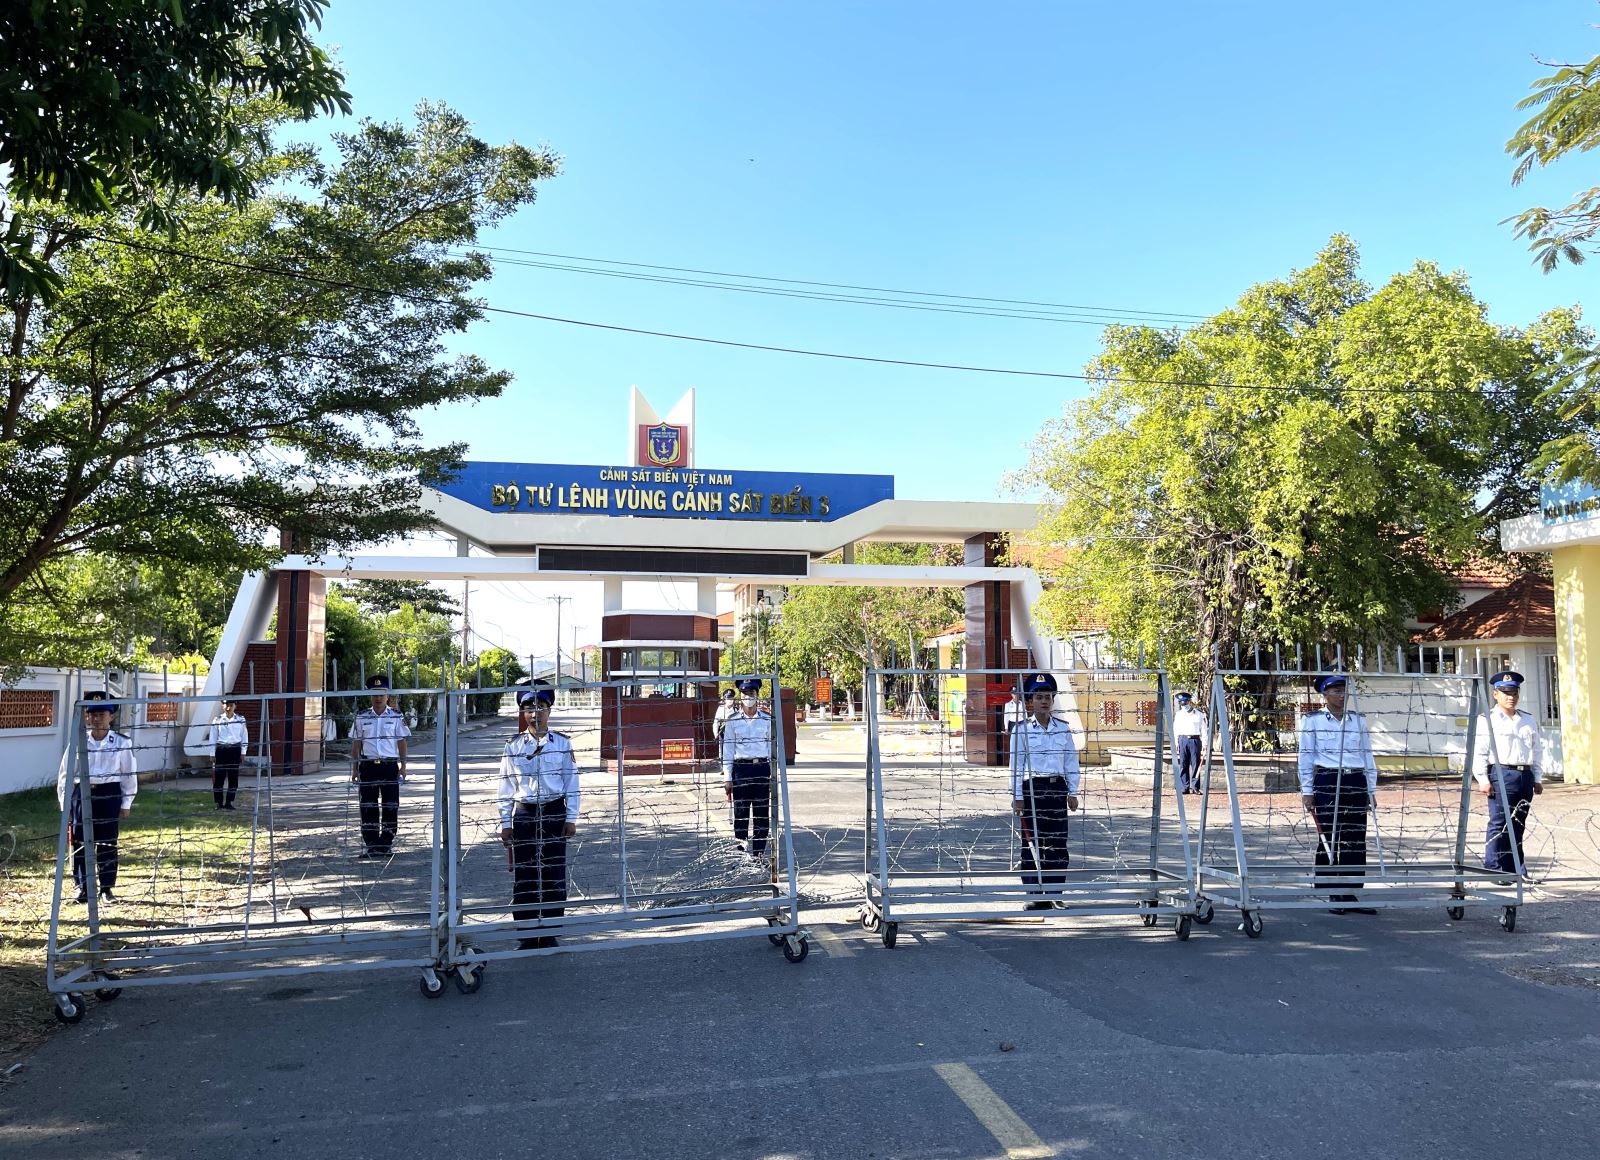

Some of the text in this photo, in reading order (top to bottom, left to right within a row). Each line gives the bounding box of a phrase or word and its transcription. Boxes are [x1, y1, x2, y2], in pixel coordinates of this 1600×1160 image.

[600, 466, 733, 486] CẢNH SÁT BIỂN VIỆT NAM
[492, 481, 520, 511] BỘ
[526, 483, 553, 507] TƯ
[615, 485, 666, 510] VÙNG
[672, 484, 722, 512] CẢNH
[729, 489, 763, 513] SÁT
[770, 485, 812, 515] BIỂN
[818, 495, 829, 515] 3
